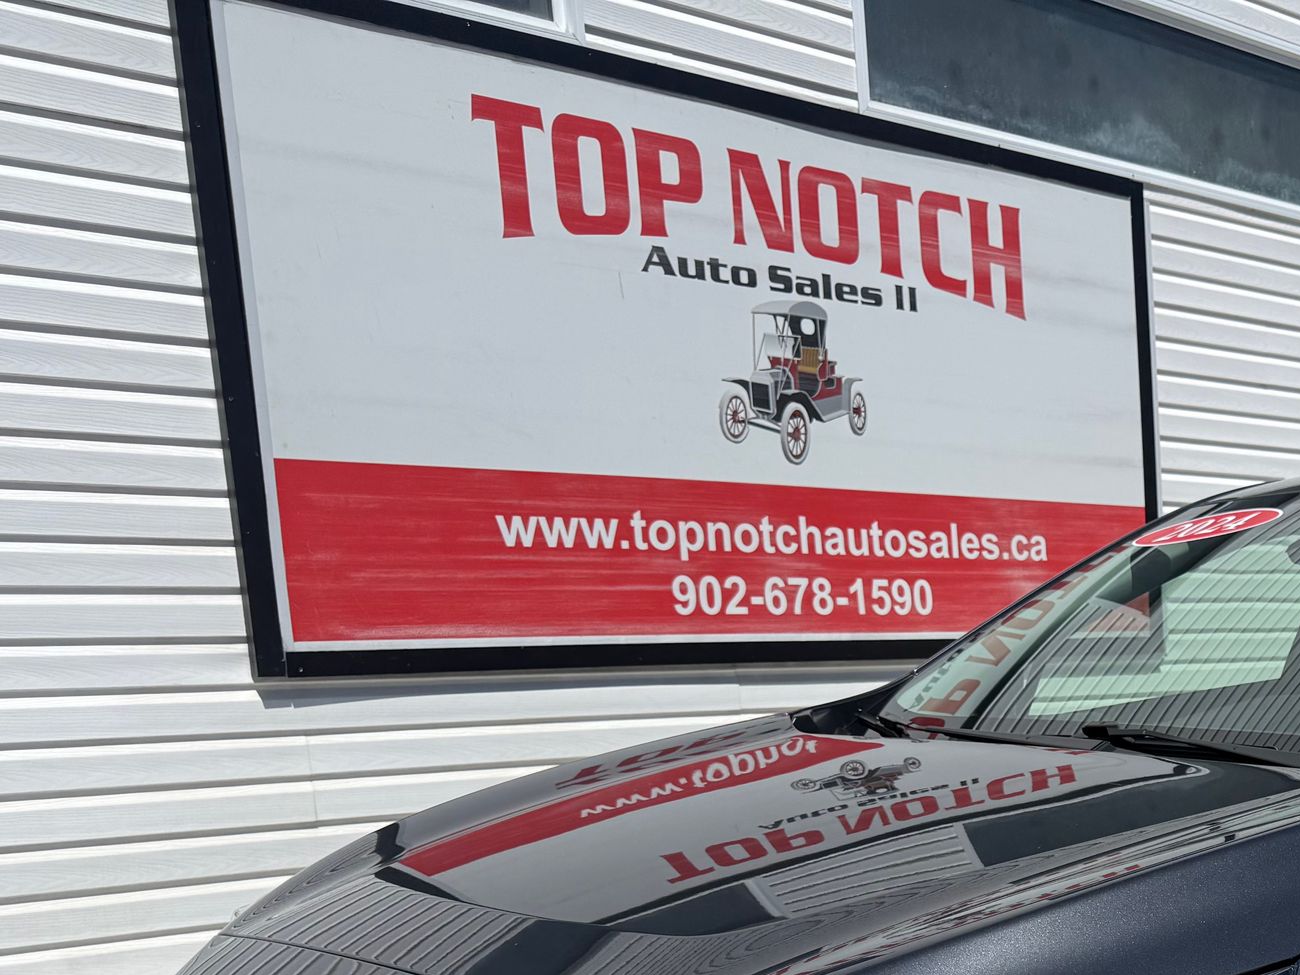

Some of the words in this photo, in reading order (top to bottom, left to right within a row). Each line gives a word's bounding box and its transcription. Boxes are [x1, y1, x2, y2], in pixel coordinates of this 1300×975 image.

[470, 93, 703, 239] TOP
[727, 147, 1027, 321] NOTCH
[641, 245, 758, 288] Auto
[768, 265, 883, 307] Sales
[895, 284, 918, 312] II
[495, 510, 1048, 561] www.topnotchautosales.ca
[1151, 511, 1262, 543] 2024
[671, 574, 933, 616] 902-678-1590
